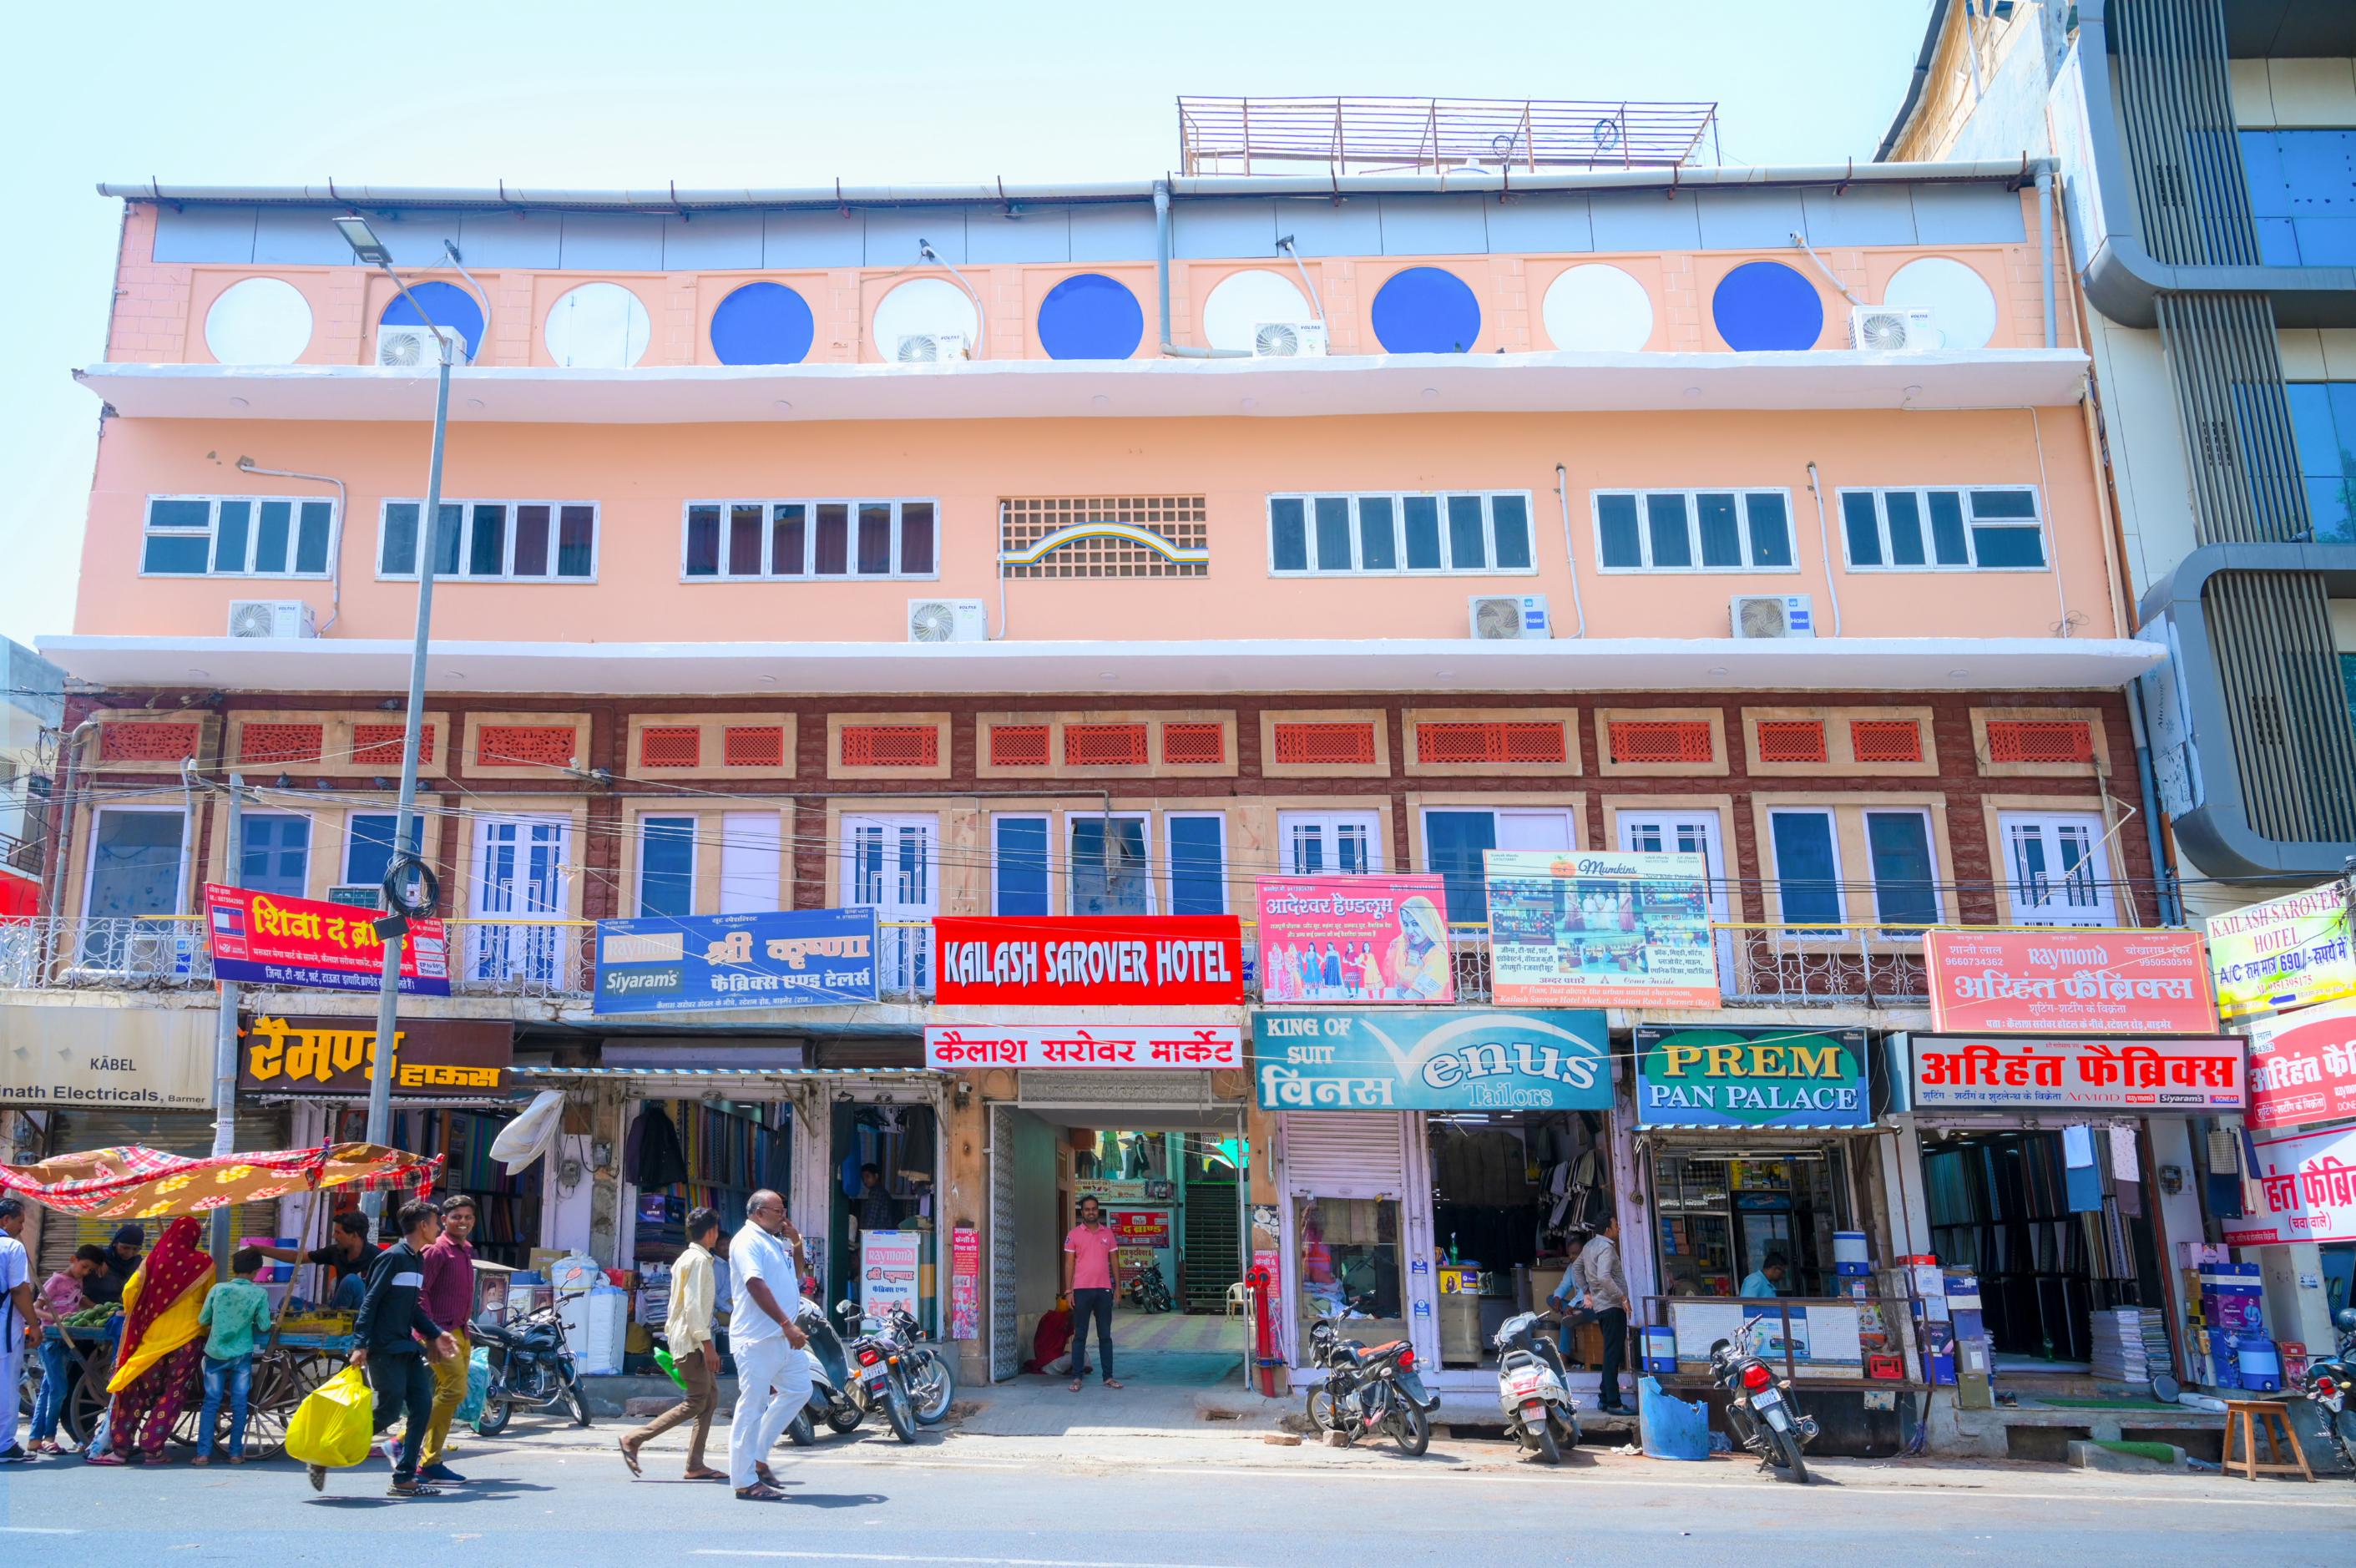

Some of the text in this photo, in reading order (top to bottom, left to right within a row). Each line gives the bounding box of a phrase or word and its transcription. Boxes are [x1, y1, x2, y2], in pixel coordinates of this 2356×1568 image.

[1579, 859, 1636, 876] Mumkins
[1266, 892, 1393, 919] आदेश्वर हैण्डलूम
[2211, 888, 2342, 938] KAILASH SAROVER
[251, 895, 321, 941] शिवा
[326, 916, 348, 949] द
[703, 931, 871, 969] श्री कृष्णा
[1949, 943, 2002, 955] शान्ती लाल
[2253, 927, 2302, 953] HOTEL
[944, 940, 1231, 989] KAILASH SAROVER HOTEL
[1945, 958, 2004, 966] 9660734362
[2027, 945, 2108, 970] Raymond
[606, 969, 679, 993] Siyaram's
[783, 974, 821, 989] एण्ड
[824, 968, 871, 988] टेलर्स
[1624, 976, 1675, 984] Come Inside
[2220, 964, 2242, 984] A/C
[1529, 986, 1548, 994] floor,
[1625, 988, 1650, 996] united
[1651, 988, 1691, 997] showroom,
[1954, 969, 2195, 1001] अरिहंत फैब्रिक्स
[1499, 994, 1528, 1003] Kailash
[1530, 995, 1558, 1004] Sarover
[1560, 995, 1580, 1004] Hotel
[1583, 995, 1610, 1005] Market,
[1613, 996, 1641, 1005] Station
[1643, 997, 1664, 1006] Road,
[1666, 998, 1694, 1006] Barmer
[2086, 1002, 2096, 1013] के
[2097, 1002, 2126, 1014] विक्रेता
[1266, 1018, 1352, 1036] KING OF
[1986, 1019, 2001, 1028] पता
[2007, 1018, 2031, 1028] कैलाश
[2033, 1018, 2055, 1028] सरोवर
[2057, 1018, 2078, 1029] होटल
[2080, 1018, 2087, 1029] के
[2257, 1030, 2273, 1040] लाल
[933, 1029, 1234, 1064] कैलाश सरोवर मार्केट
[1287, 1046, 1336, 1065] SUIT
[90, 1055, 137, 1071] KĀBEL
[1661, 1045, 1844, 1080] PREM
[1921, 1044, 2238, 1089] अरिहंत फैब्रिक्स
[2249, 1051, 2323, 1092] अरिहंत
[400, 1064, 501, 1087] हाऊस
[1261, 1064, 1396, 1107] विनस
[0, 1085, 206, 1104] nath Electricals, Barmer
[1462, 1082, 1553, 1107] Tailors
[1649, 1085, 1859, 1111] PAN PALACE
[1923, 1090, 1945, 1103] शुटिंग
[2023, 1090, 2032, 1100] के
[2035, 1090, 2062, 1100] विक्रेता
[2126, 1095, 2154, 1103] Raymond
[2161, 1095, 2203, 1103] Siyaram's
[868, 1249, 913, 1264] Raymond
